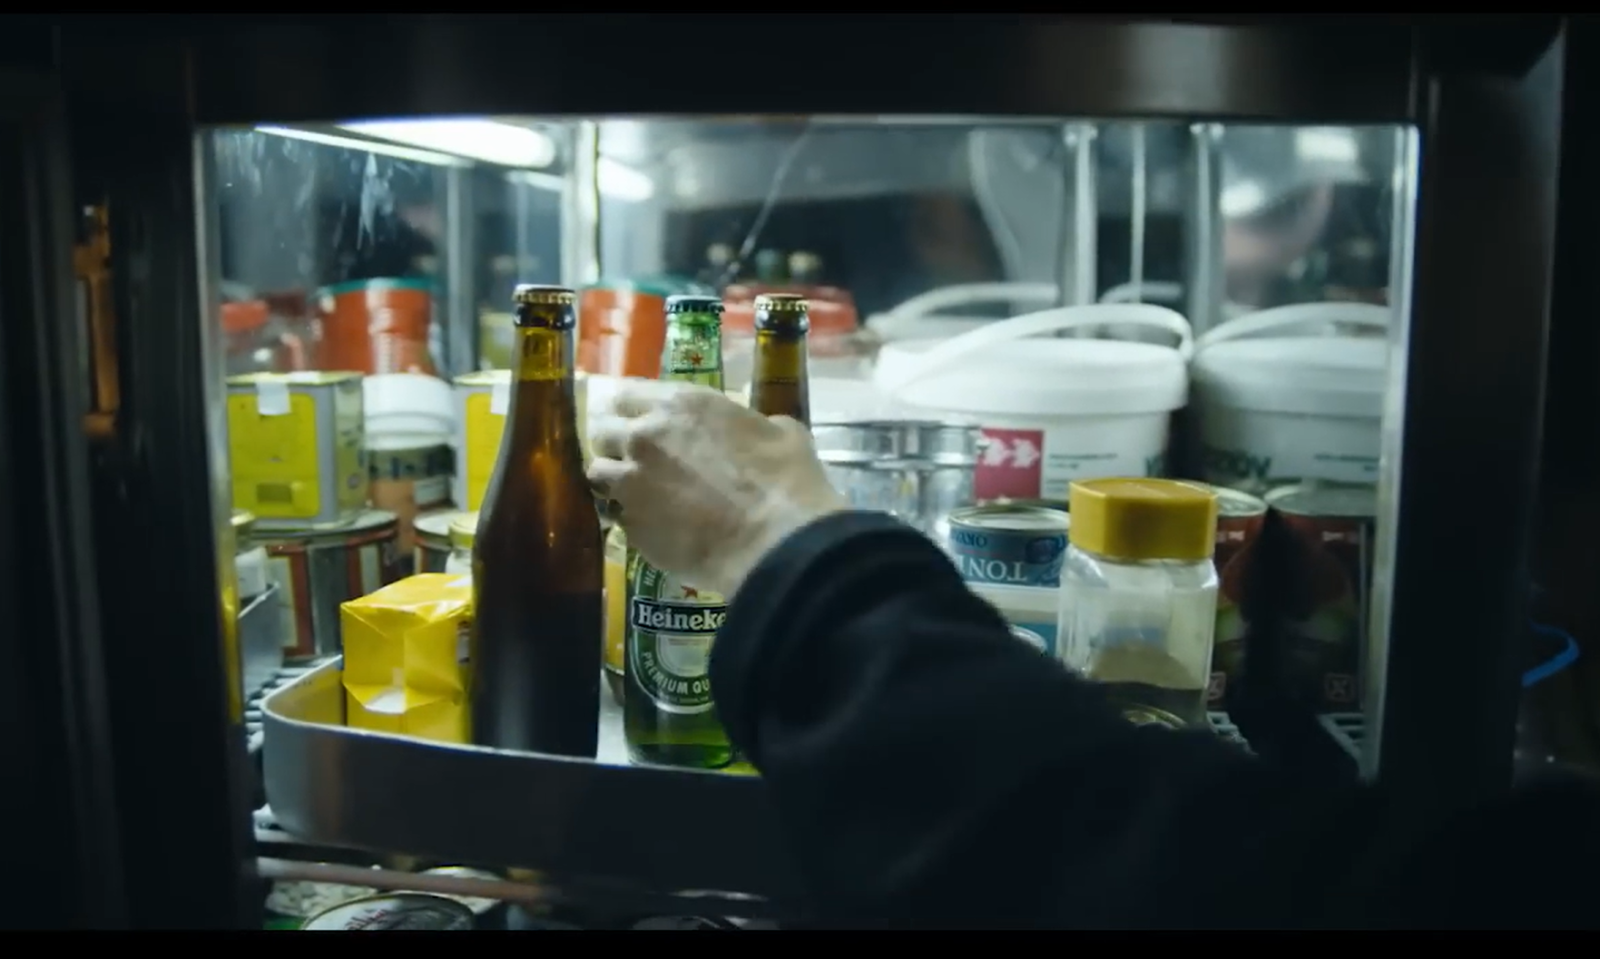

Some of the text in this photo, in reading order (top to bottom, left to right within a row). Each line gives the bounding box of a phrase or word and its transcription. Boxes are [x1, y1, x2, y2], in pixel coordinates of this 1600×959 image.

[637, 603, 726, 631] Heineke
[642, 651, 711, 695] PREMIUM QU
